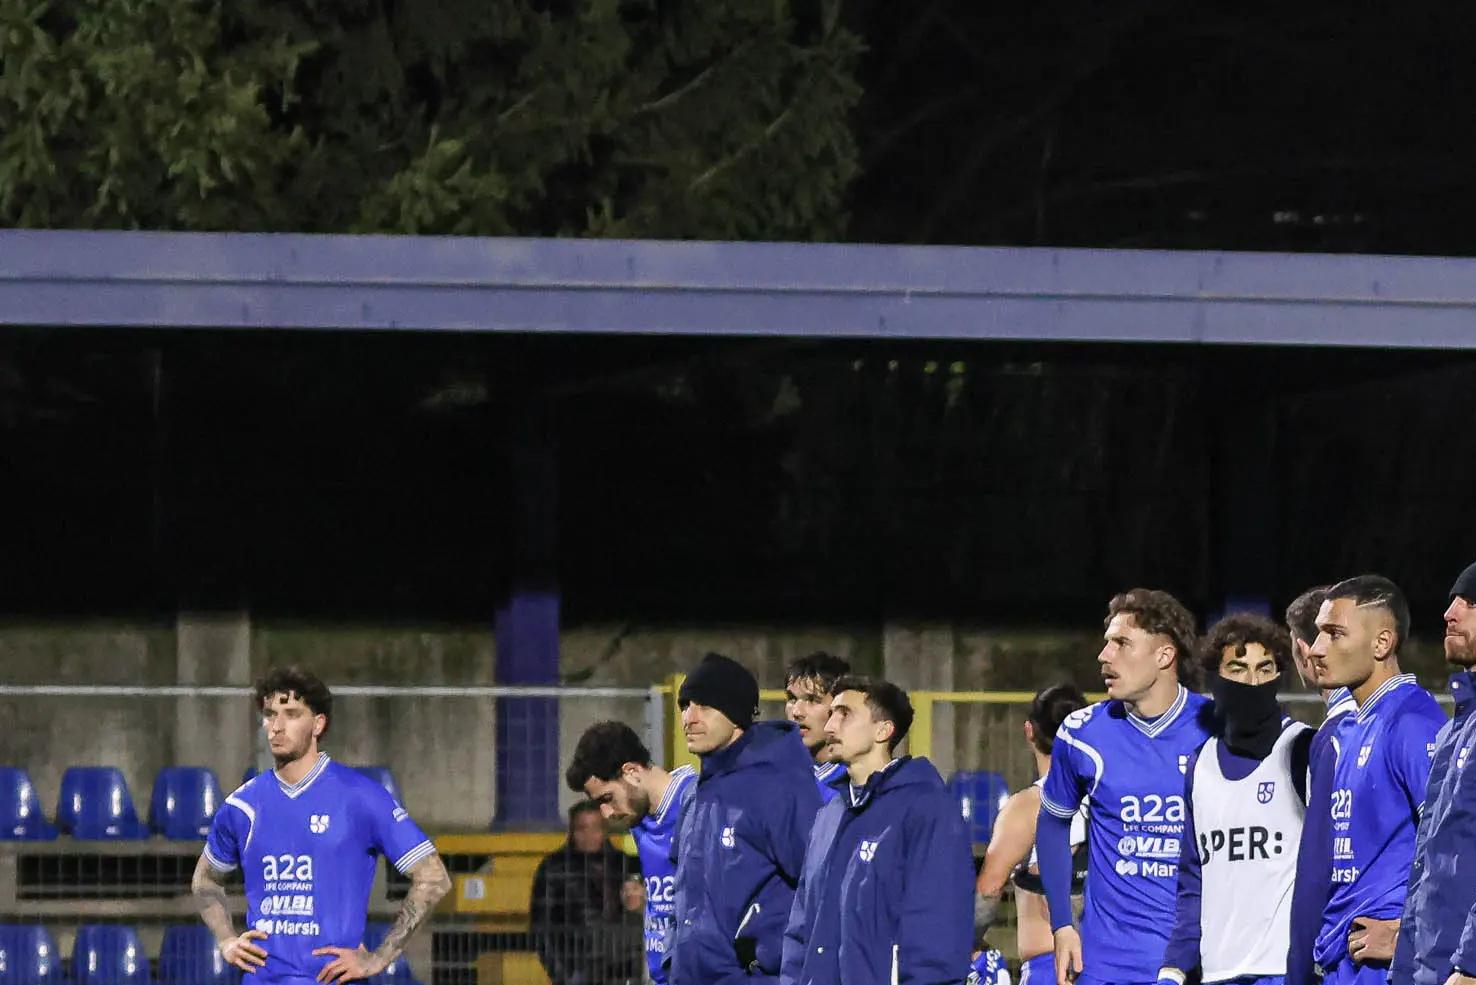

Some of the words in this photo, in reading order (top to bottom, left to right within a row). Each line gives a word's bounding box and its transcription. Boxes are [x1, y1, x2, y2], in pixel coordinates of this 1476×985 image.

[1120, 793, 1184, 823] a2a
[262, 854, 313, 881] a2a
[1142, 861, 1179, 878] Mar
[275, 919, 320, 936] Marsh
